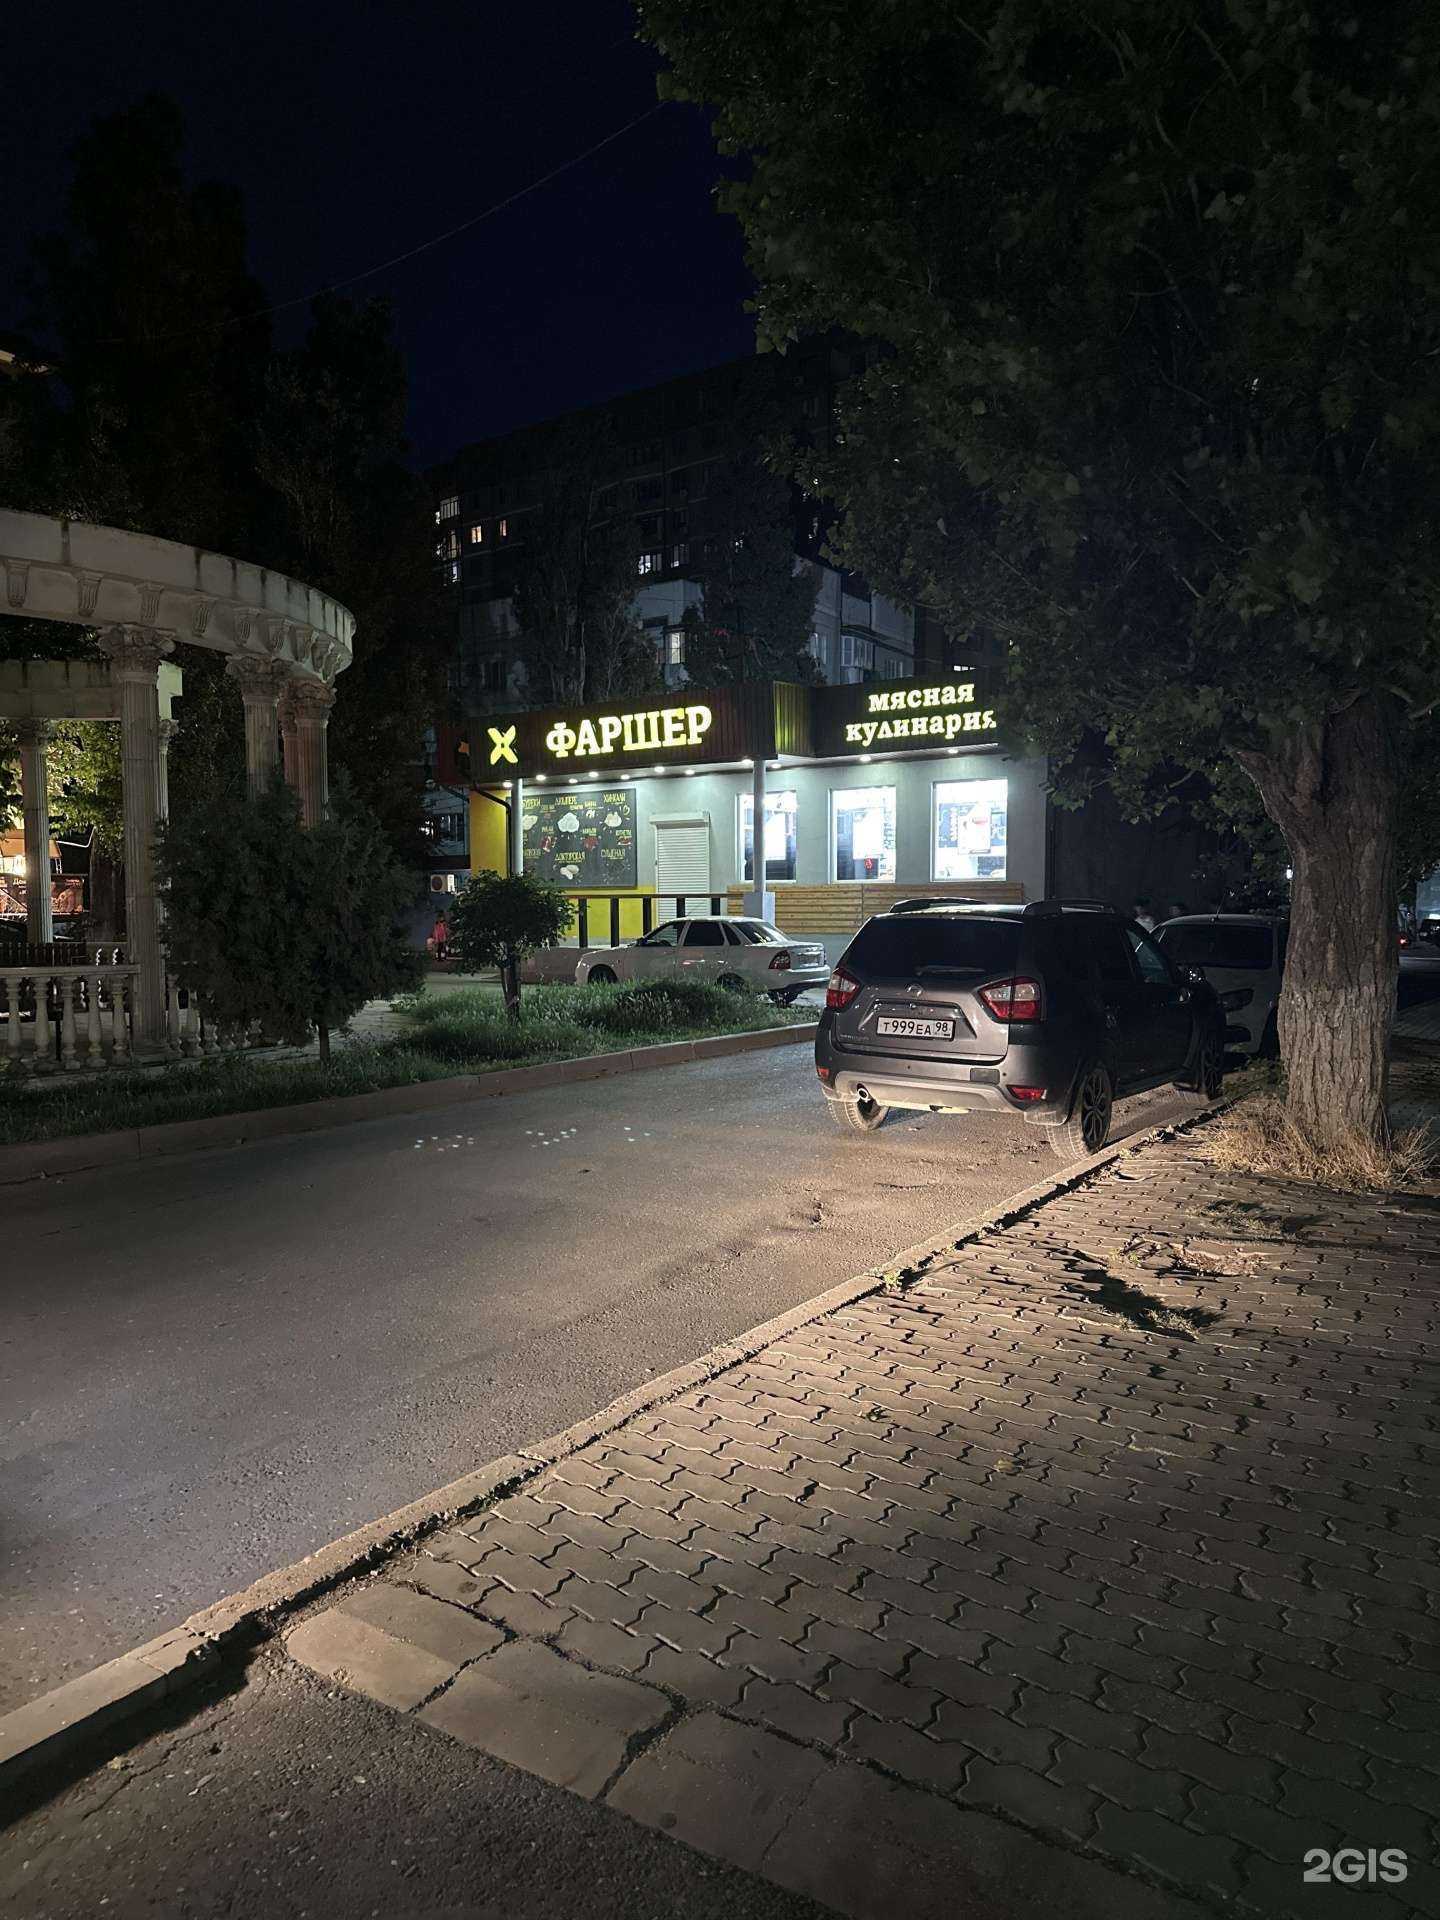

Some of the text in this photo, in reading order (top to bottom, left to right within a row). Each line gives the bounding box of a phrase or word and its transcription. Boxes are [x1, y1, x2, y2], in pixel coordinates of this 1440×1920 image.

[868, 683, 975, 712] мясная
[545, 705, 712, 758] ФАРШЕР
[883, 1020, 949, 1036] Т999ЕА 98
